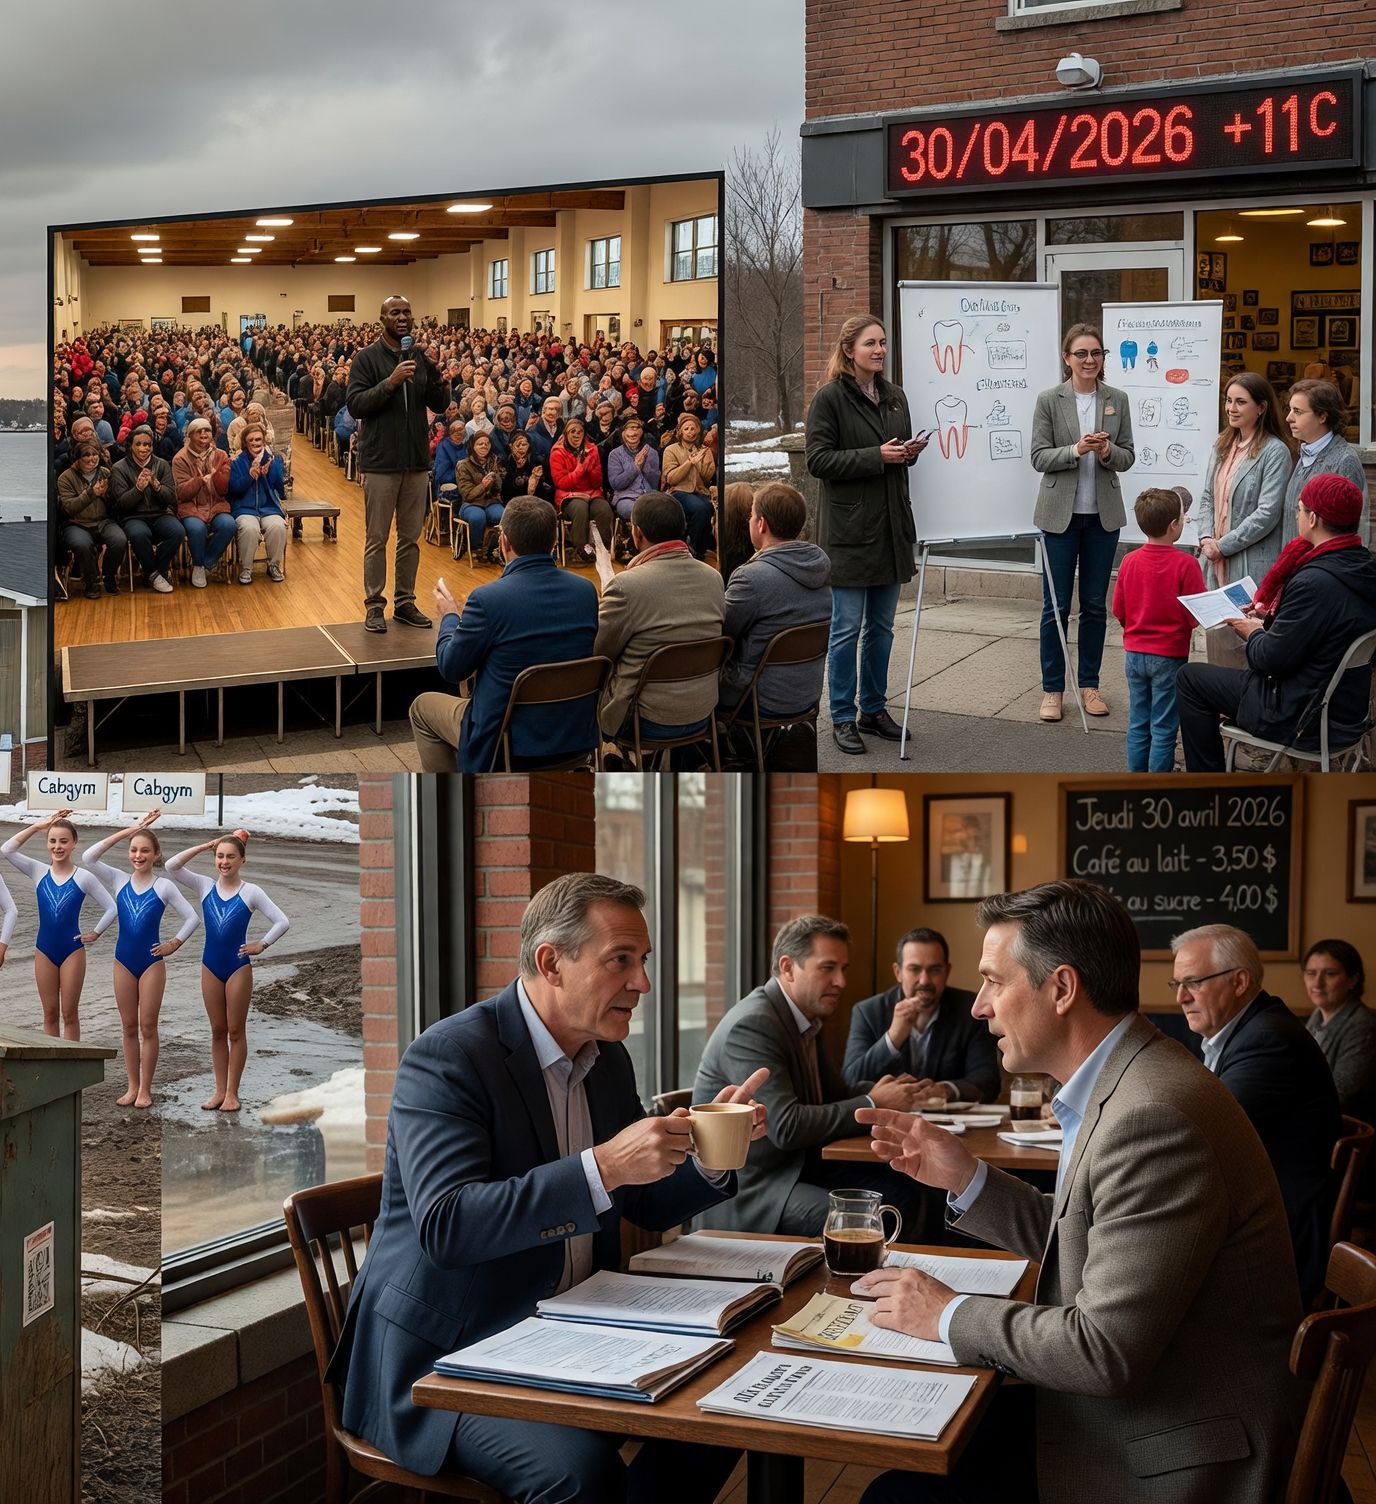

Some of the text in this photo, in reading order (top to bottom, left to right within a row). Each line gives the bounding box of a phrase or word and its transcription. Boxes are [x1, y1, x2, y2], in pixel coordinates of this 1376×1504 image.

[899, 104, 1194, 182] 30/04/2026
[37, 776, 96, 803] Cabgym
[133, 777, 193, 805] Cabgym
[1076, 794, 1286, 831] Jeudi 30 avril 2026
[1073, 844, 1122, 875] Café
[1126, 856, 1150, 873] au
[1157, 843, 1191, 873] lait
[1211, 845, 1259, 874] 3,50
[1262, 842, 1277, 874] $
[1127, 893, 1148, 911] au
[1154, 893, 1202, 911] sucre
[1218, 884, 1262, 912] 4,00
[1264, 883, 1278, 914] $
